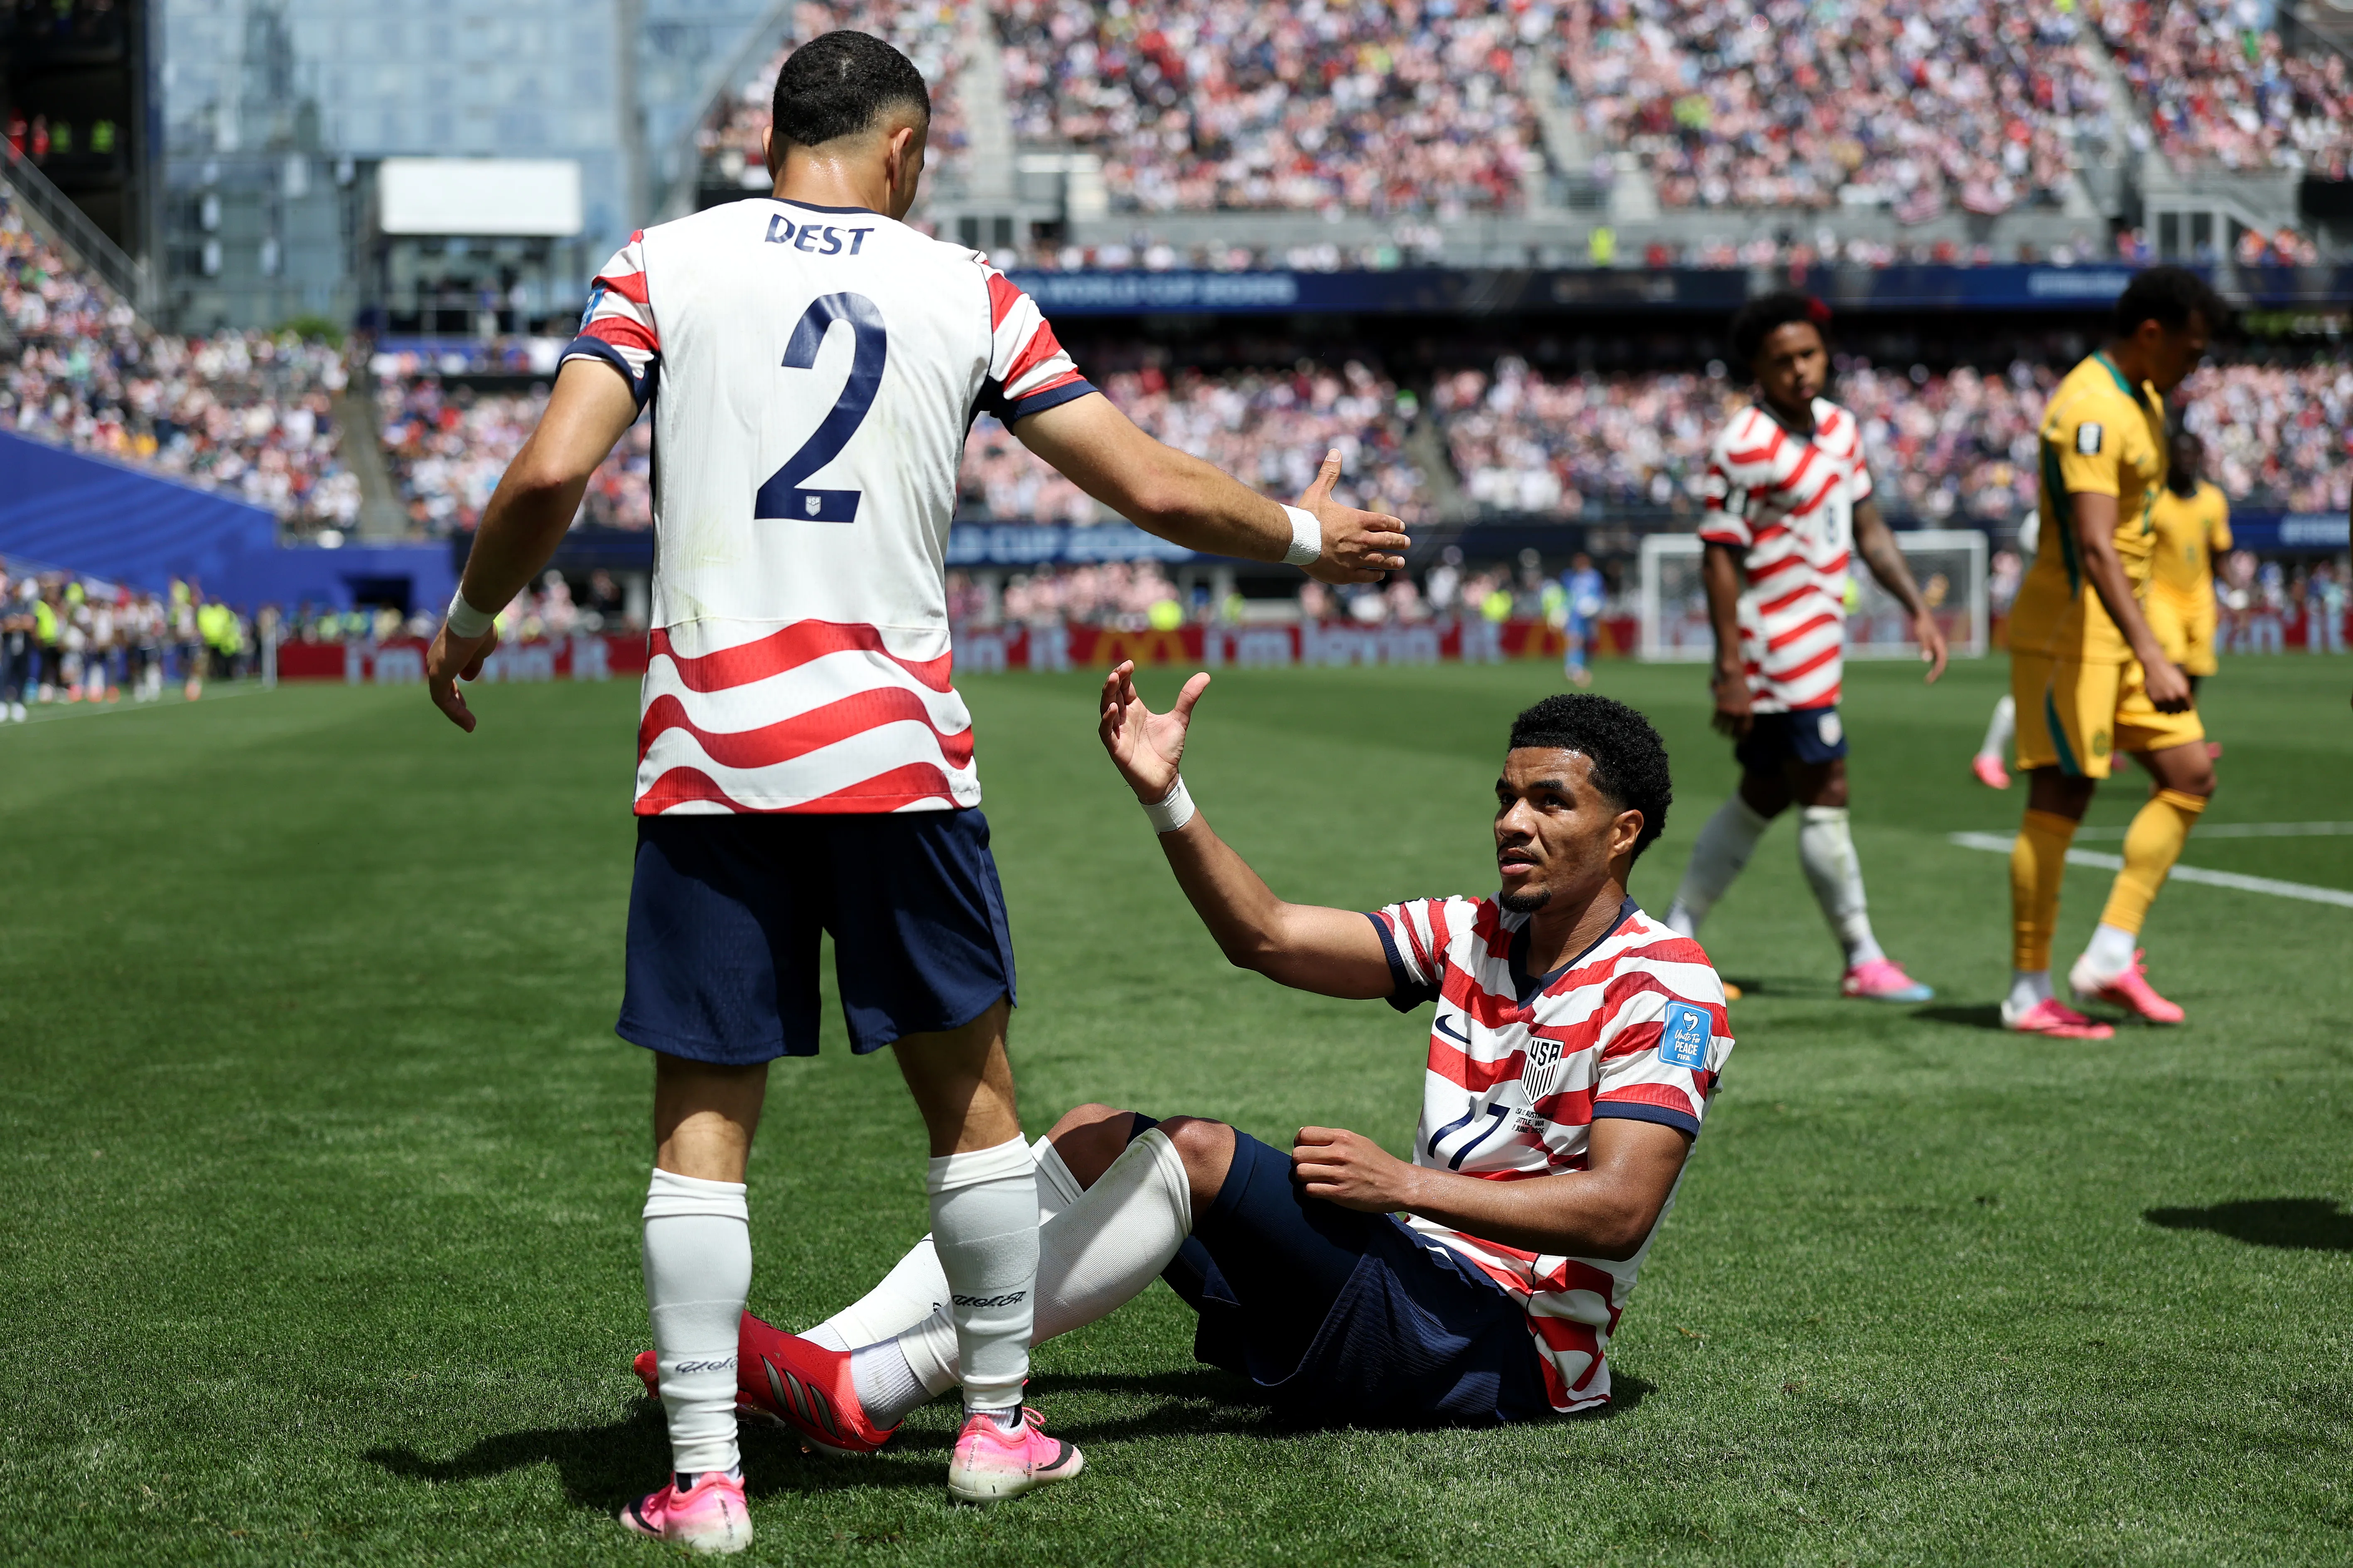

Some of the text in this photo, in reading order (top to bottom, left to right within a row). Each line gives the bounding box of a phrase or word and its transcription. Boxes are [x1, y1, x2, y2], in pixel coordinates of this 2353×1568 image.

[765, 213, 875, 255] DEST
[754, 291, 888, 523] 2
[1674, 1041, 1698, 1056] PEACE
[1675, 1029, 1700, 1044] Unite For
[1530, 1040, 1561, 1067] USA
[1525, 1110, 1554, 1119] AUSTRALIA
[1427, 1095, 1511, 1172] 17
[1515, 1125, 1529, 1134] JUNE
[967, 1443, 977, 1472] VAPOR
